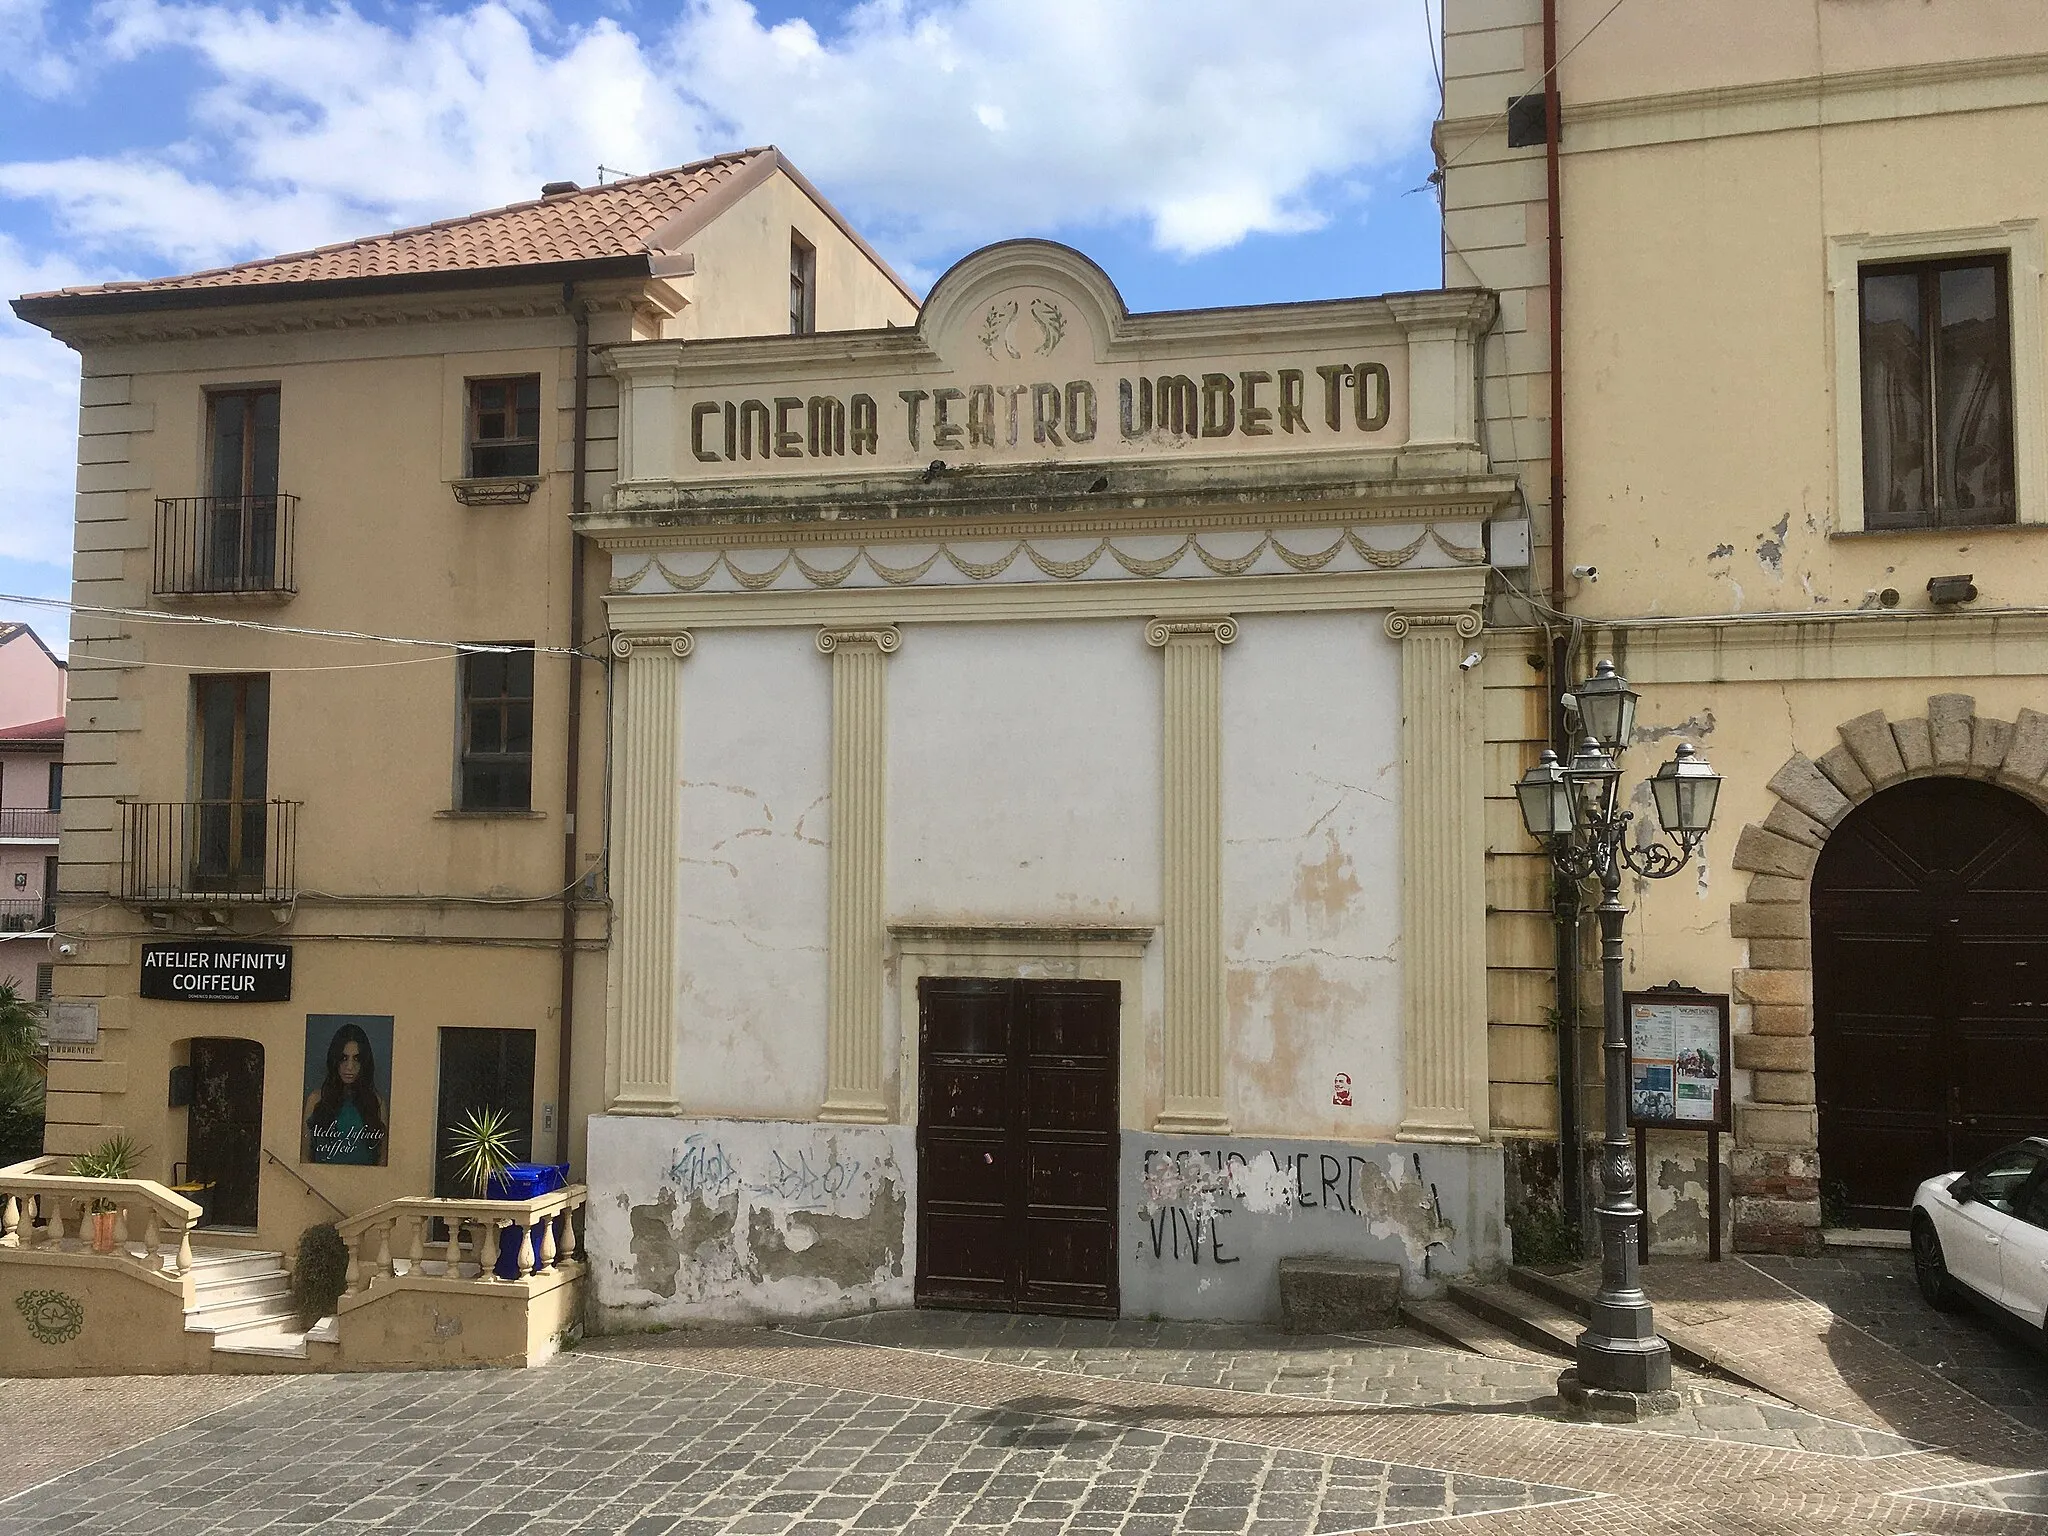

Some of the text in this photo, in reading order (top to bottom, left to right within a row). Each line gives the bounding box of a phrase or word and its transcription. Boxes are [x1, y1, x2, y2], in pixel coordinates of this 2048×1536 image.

[691, 362, 1390, 462] CINEMA TEATRO UMBERTO
[145, 952, 286, 970] ATELIER INFINITY
[173, 974, 256, 992] COIFFEUR
[305, 1120, 385, 1150] Atelier Infinity
[316, 1139, 358, 1160] coiffeur
